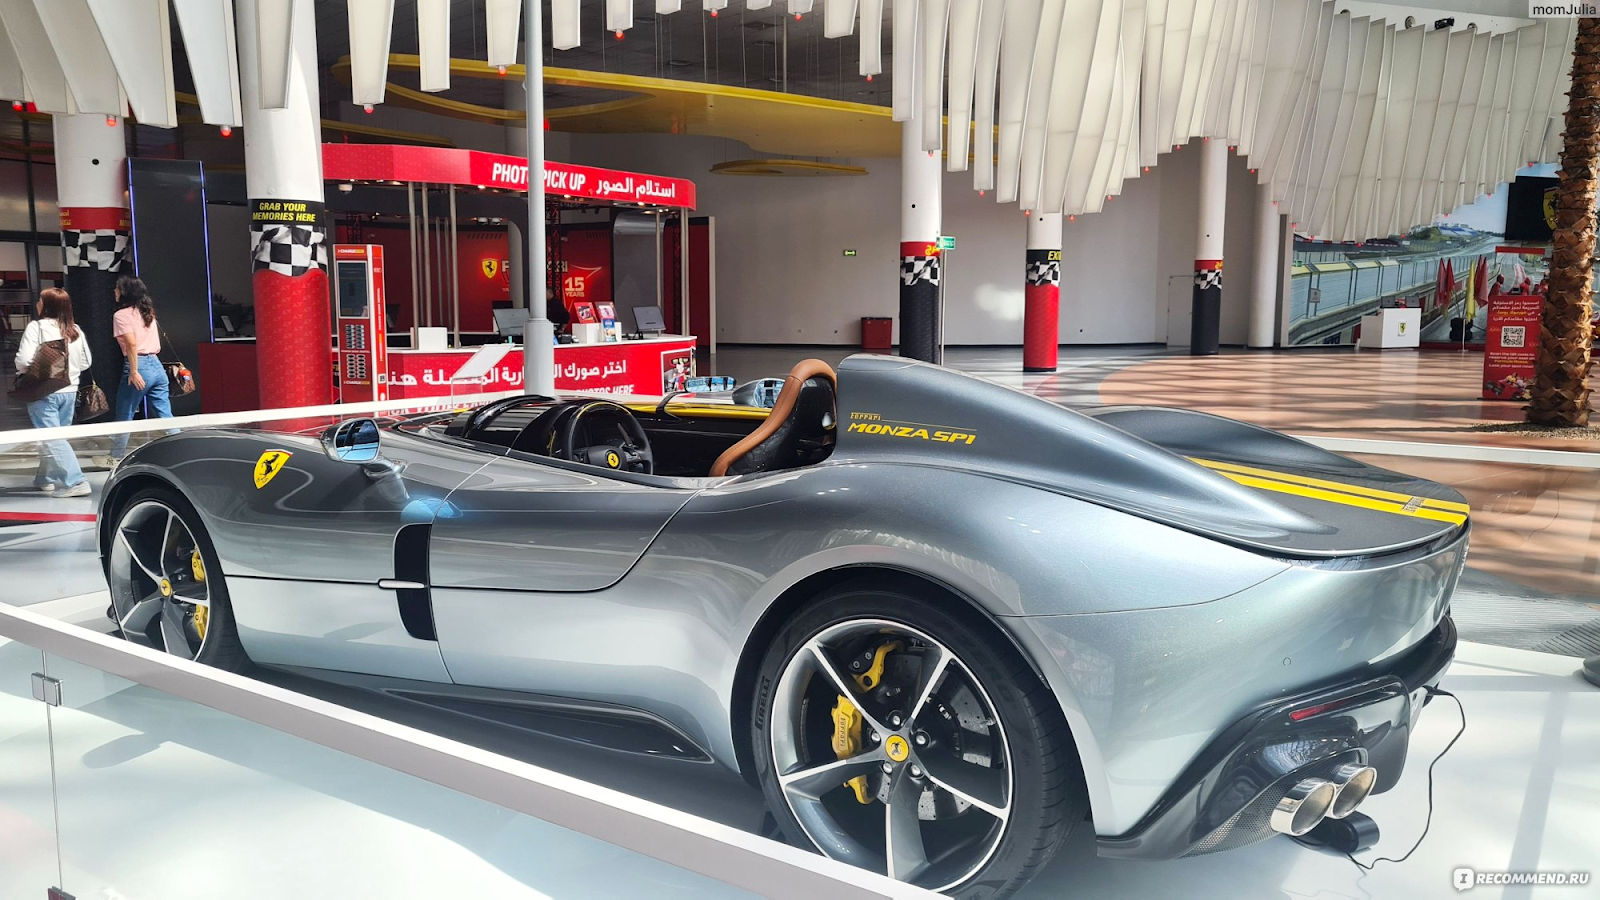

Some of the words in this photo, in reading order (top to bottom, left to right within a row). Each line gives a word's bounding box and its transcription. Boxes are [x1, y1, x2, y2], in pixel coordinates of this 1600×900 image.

[491, 162, 529, 185] PHOT
[568, 172, 586, 191] UP
[595, 177, 634, 196] الصور
[635, 179, 675, 199] استلام
[259, 202, 281, 211] GRAB
[283, 202, 306, 212] YOUR
[252, 212, 295, 221] MEMORIES
[295, 213, 316, 222] HERE
[564, 276, 585, 292] 15
[388, 370, 418, 386] هن
[564, 362, 600, 381] صورك
[601, 359, 627, 379] اختر
[850, 412, 881, 421] Ferrari
[847, 422, 929, 440] MONZA
[754, 675, 771, 731] PIRELLI
